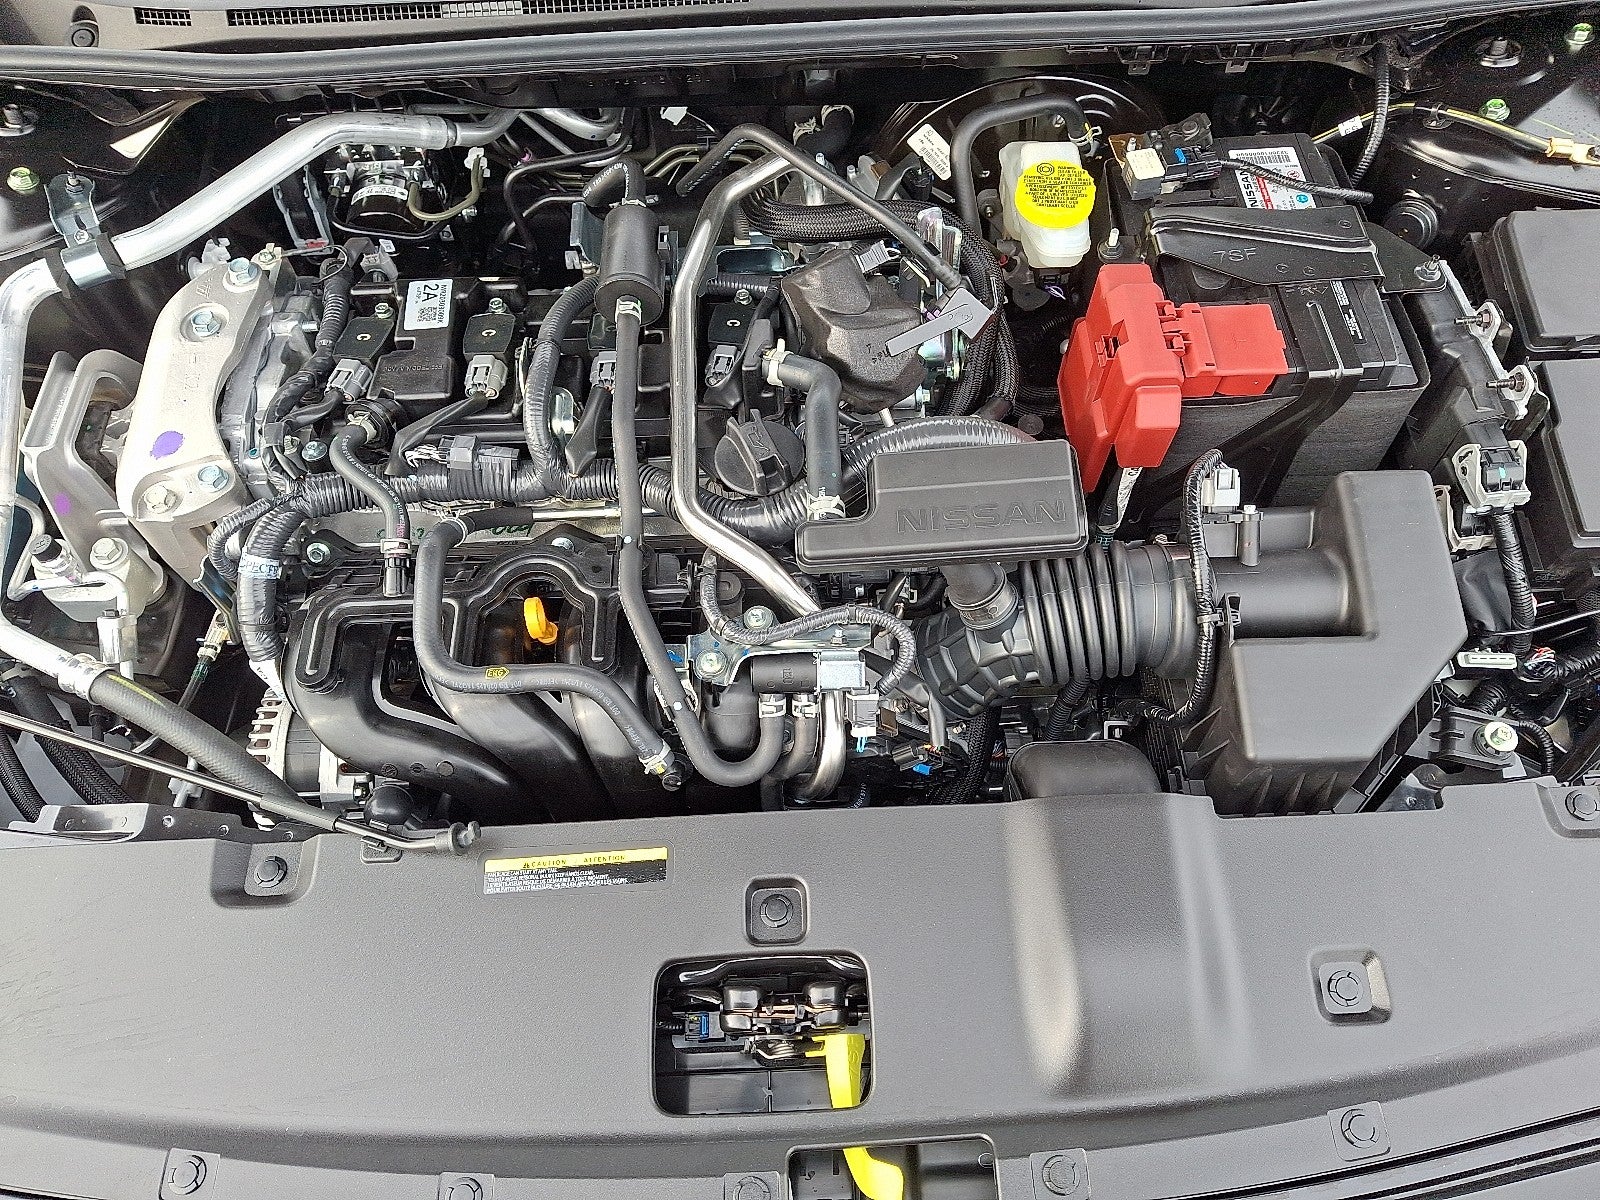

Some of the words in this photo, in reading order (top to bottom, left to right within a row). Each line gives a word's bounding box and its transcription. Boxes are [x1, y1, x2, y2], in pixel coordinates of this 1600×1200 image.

[421, 283, 440, 303] 2A
[895, 498, 1067, 534] NISSAN
[531, 859, 567, 868] CAUTION
[583, 855, 626, 863] ATTENTION
